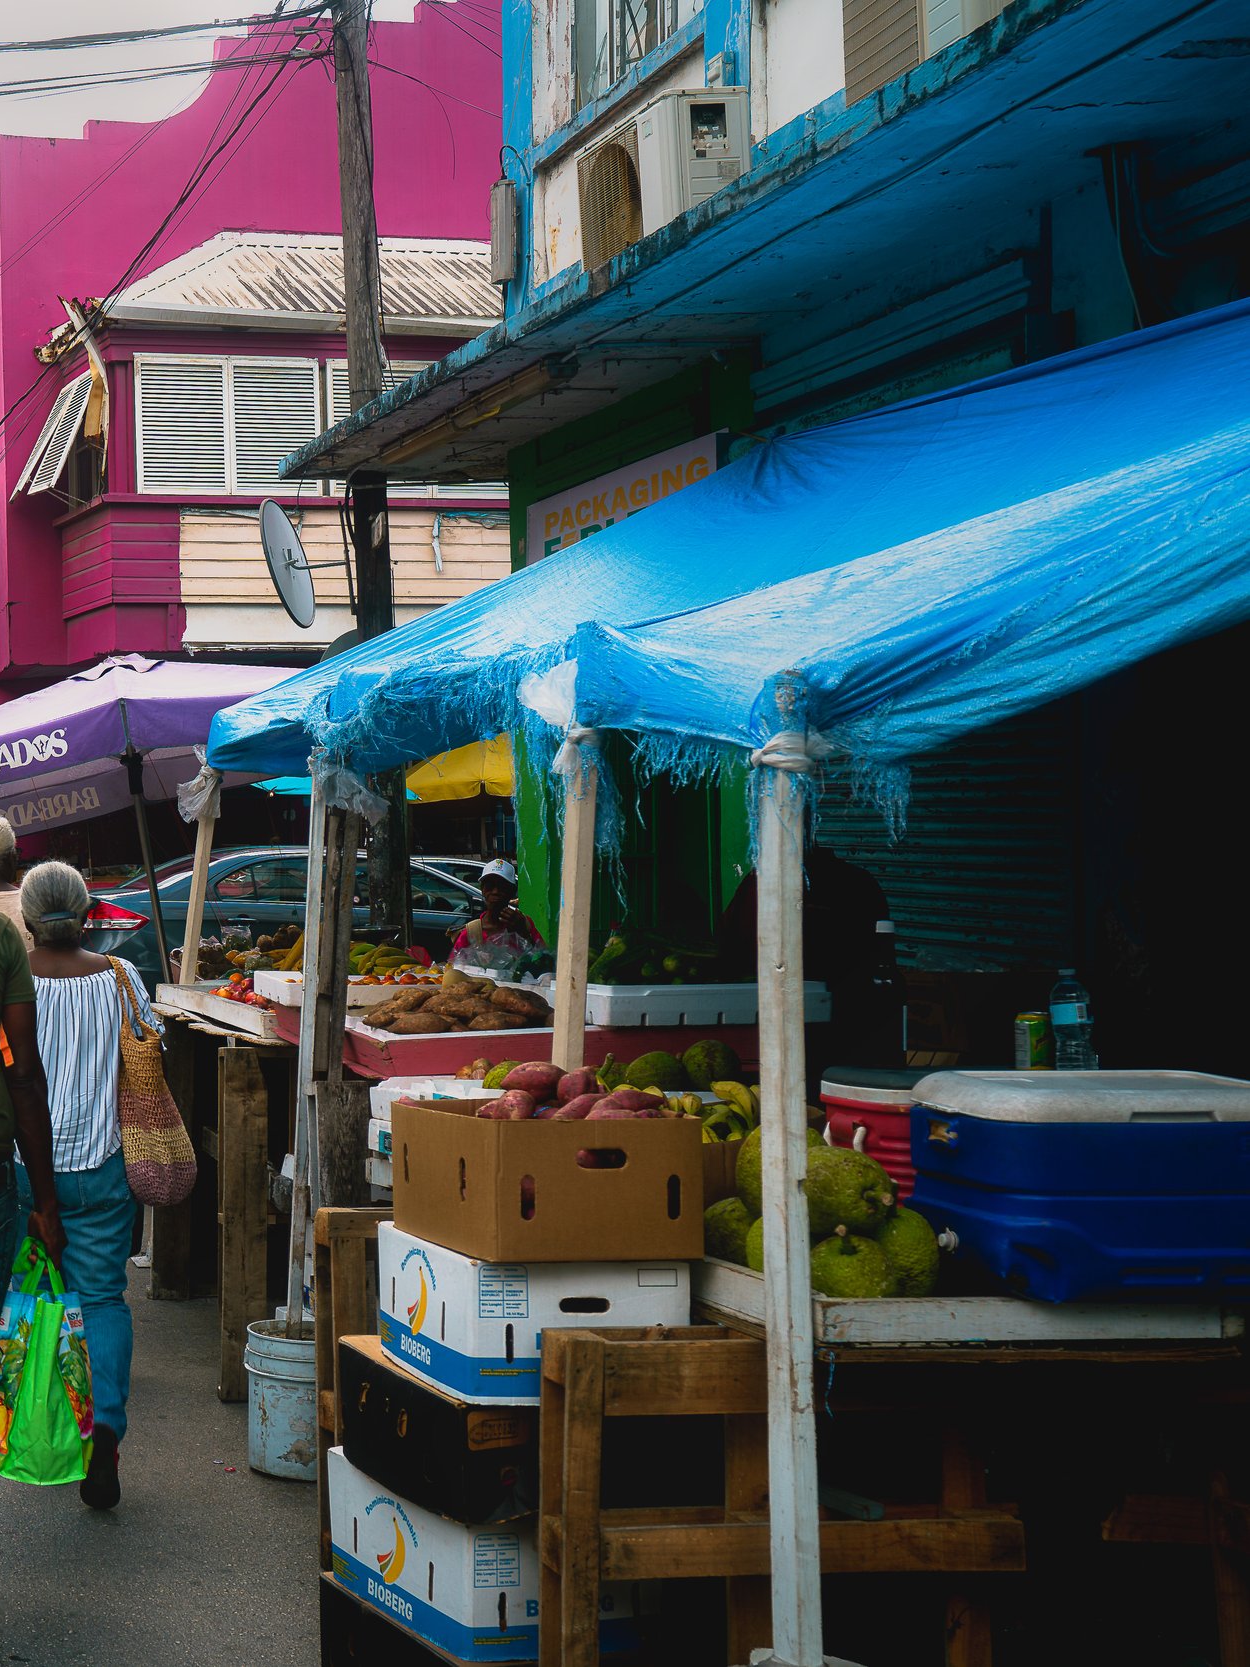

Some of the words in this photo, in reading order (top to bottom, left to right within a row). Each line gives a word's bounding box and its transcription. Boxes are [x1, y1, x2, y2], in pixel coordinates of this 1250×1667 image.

[544, 456, 710, 539] PACKAGING
[401, 1247, 422, 1271] Dominican
[422, 1250, 437, 1291] Republic
[401, 1334, 430, 1366] BIOBERG
[365, 1494, 395, 1516] Dominican
[396, 1502, 419, 1549] Republic
[367, 1577, 413, 1622] BIOBERG
